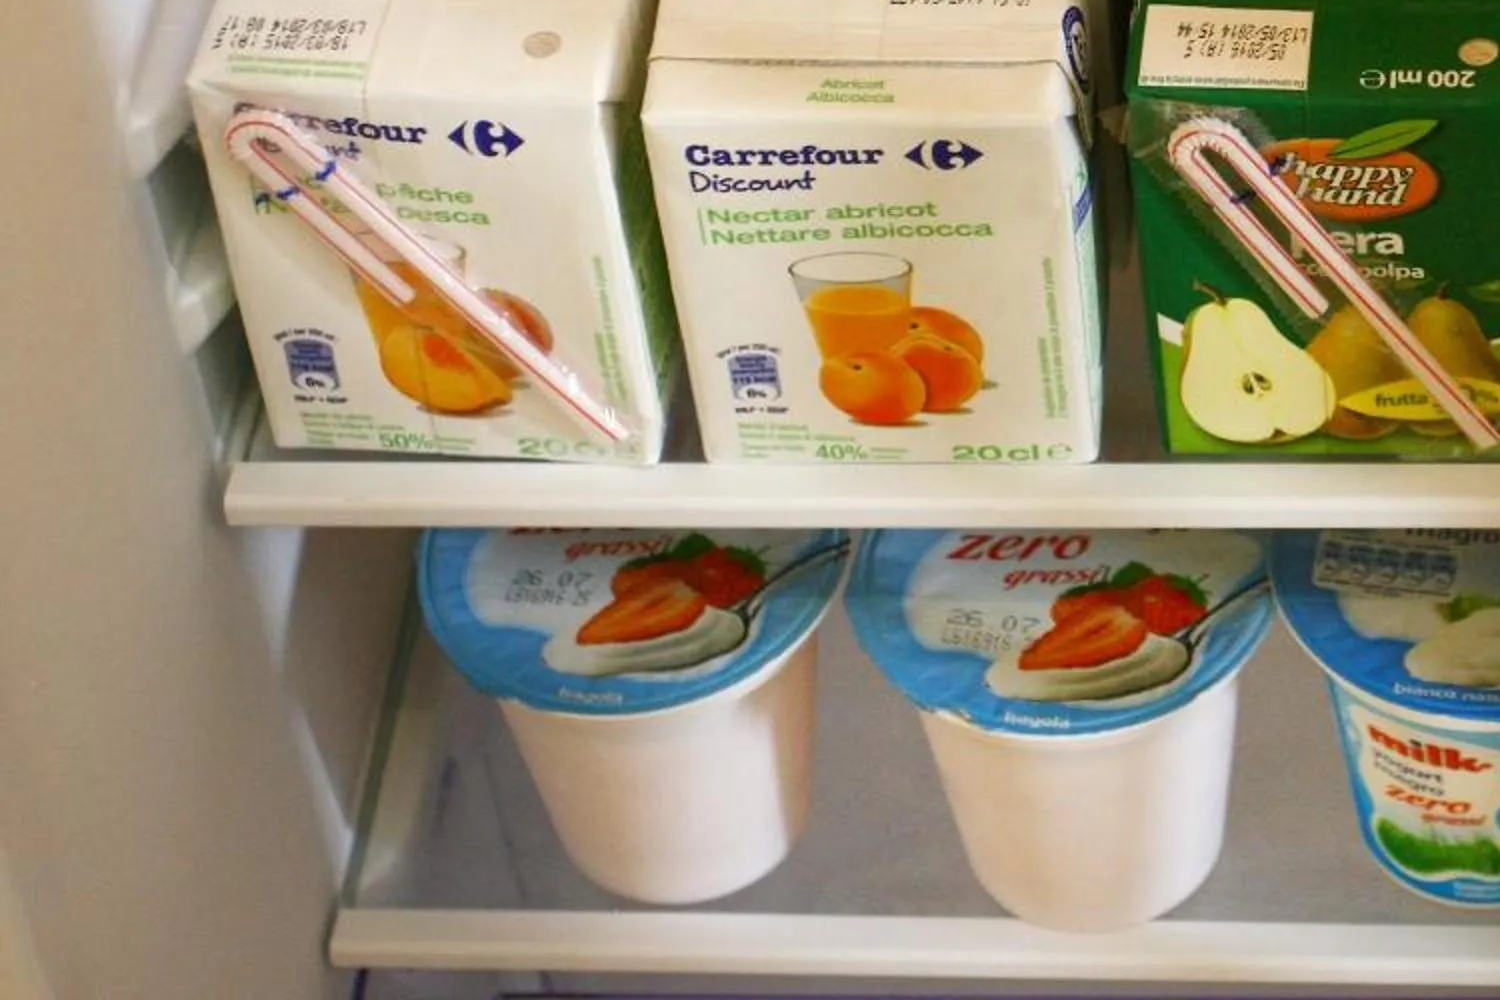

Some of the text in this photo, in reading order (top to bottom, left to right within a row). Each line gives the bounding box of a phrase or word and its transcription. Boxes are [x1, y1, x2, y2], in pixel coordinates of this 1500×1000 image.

[821, 79, 885, 90] Abricot
[1390, 70, 1475, 88] 200 ml
[685, 144, 885, 167] Carrefour
[1281, 152, 1414, 187] happy
[689, 171, 816, 193] Discount
[1297, 177, 1407, 206] hand
[707, 202, 939, 225] Nectar abricot
[709, 221, 993, 246] Nettare albicocca
[1374, 392, 1428, 408] frutta
[816, 444, 868, 460] 40%
[947, 533, 1092, 561] zero
[1367, 724, 1494, 773] milk
[1383, 784, 1472, 815] zero
